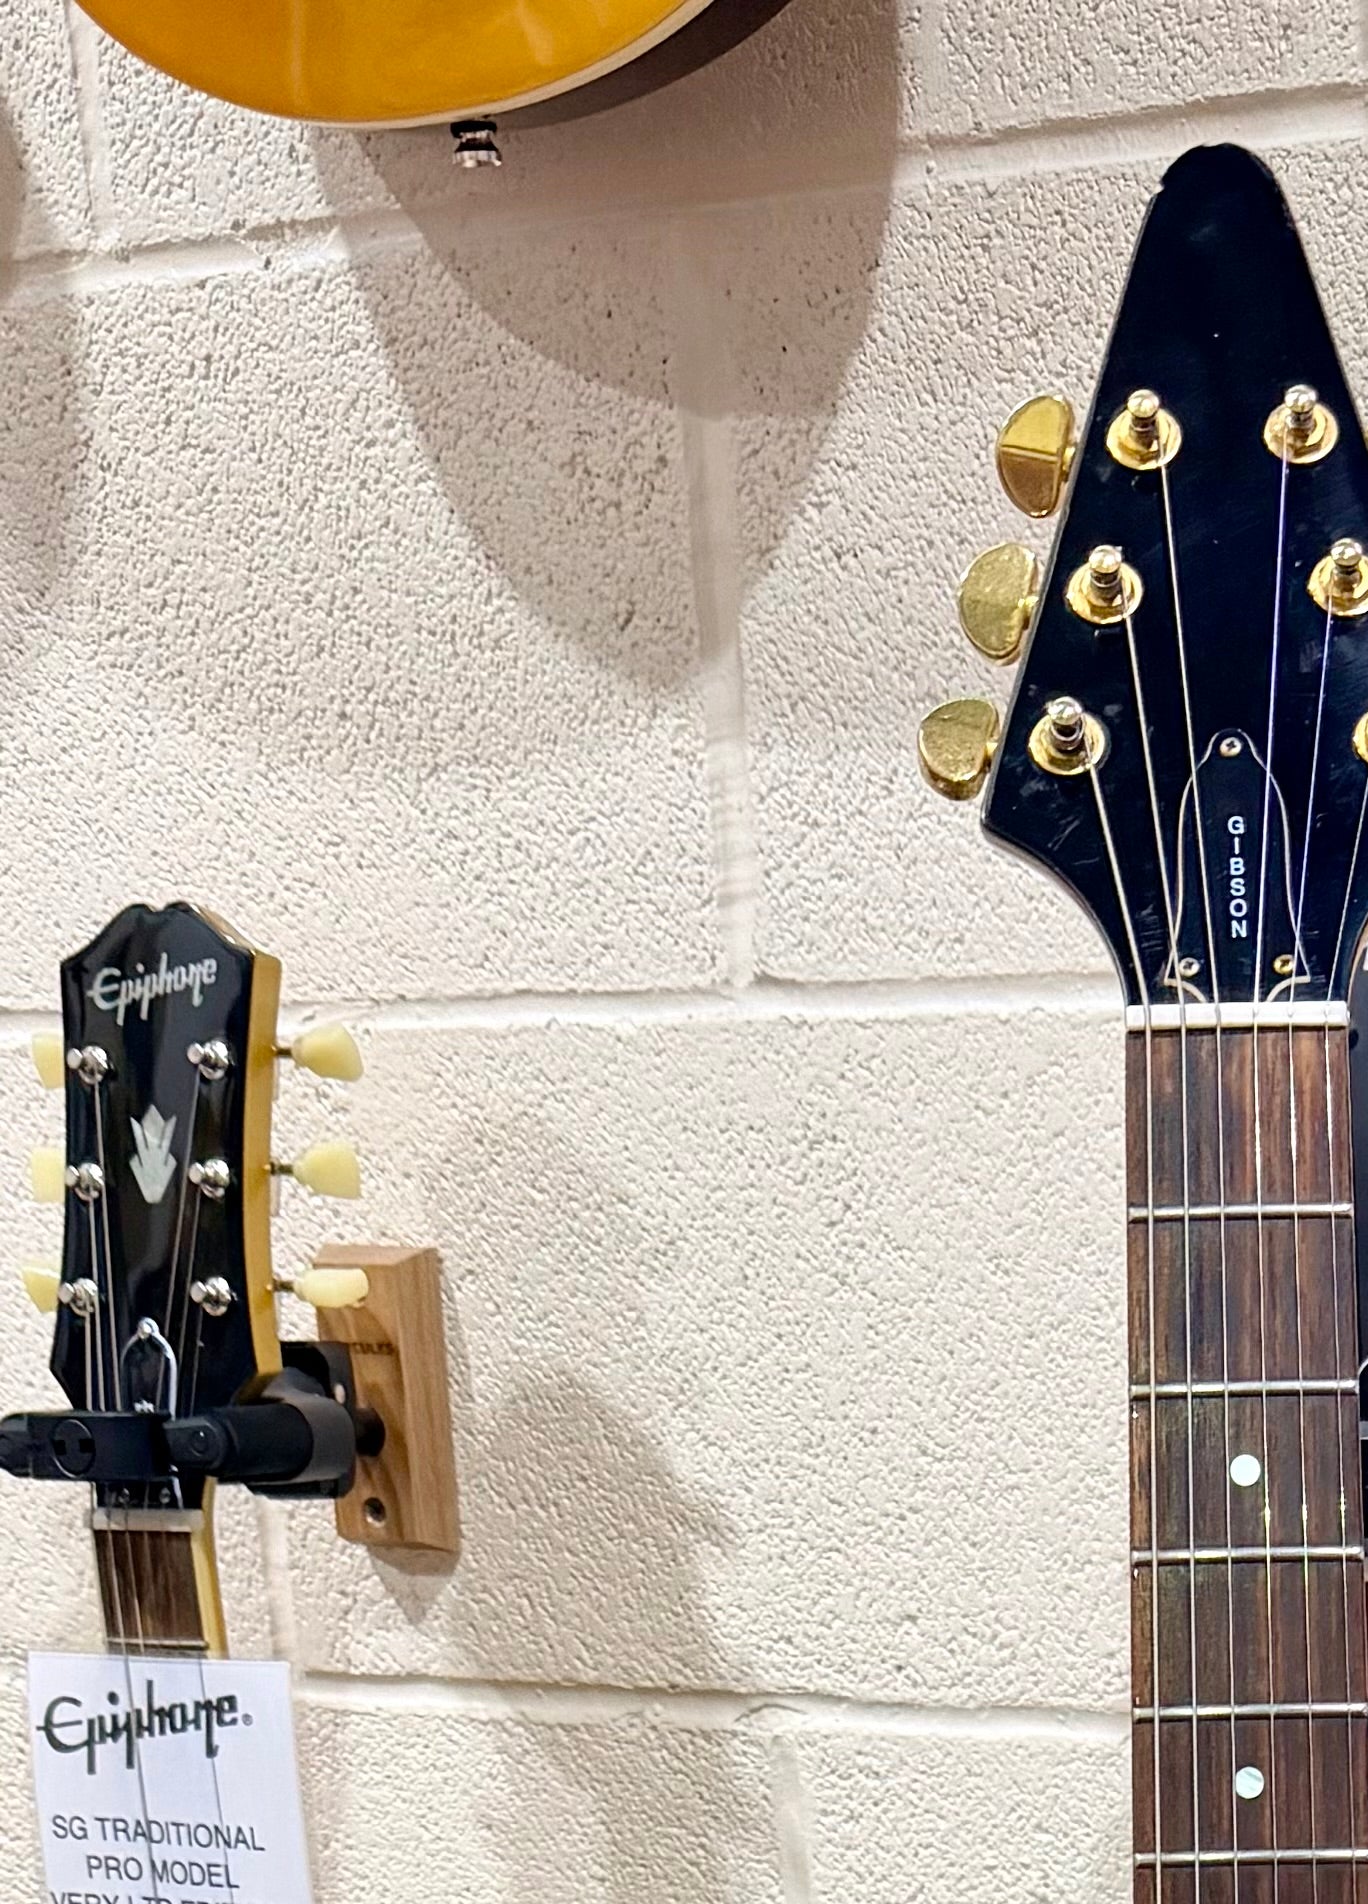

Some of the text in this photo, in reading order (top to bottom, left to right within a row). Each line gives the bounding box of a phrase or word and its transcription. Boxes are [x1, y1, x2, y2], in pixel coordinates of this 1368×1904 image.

[1227, 815, 1248, 939] GIBSON
[86, 951, 218, 1027] Epiphone
[51, 1814, 266, 1851] SG TRADITIONAL
[86, 1855, 241, 1889] PRO MODEL
